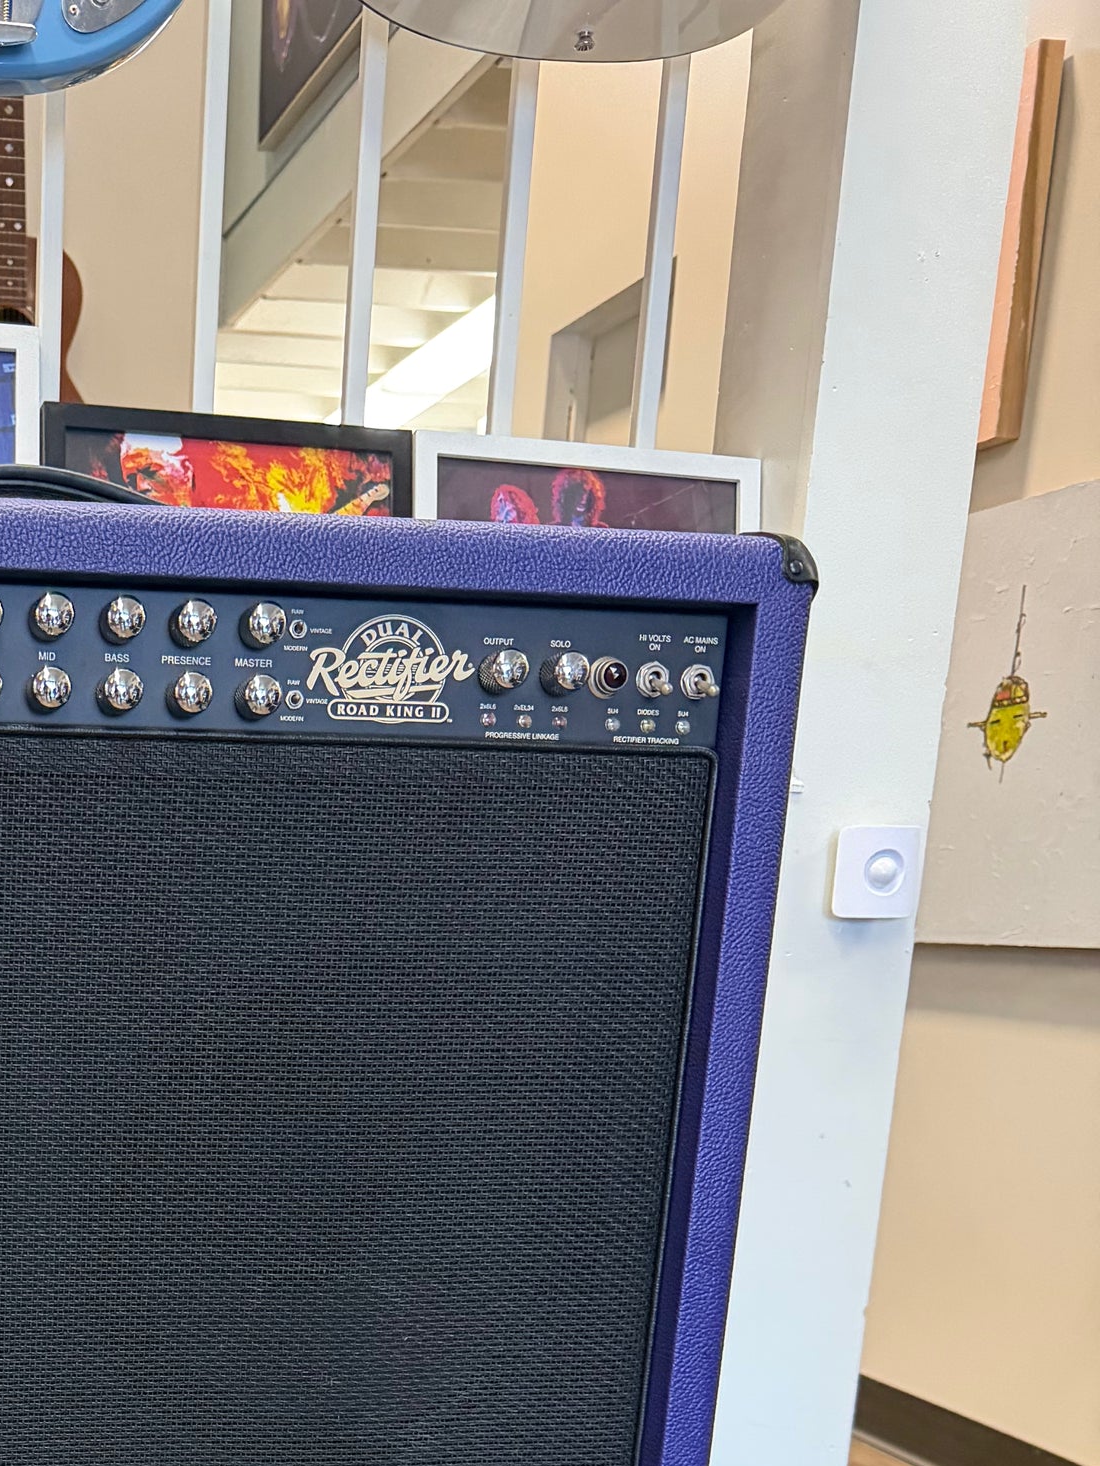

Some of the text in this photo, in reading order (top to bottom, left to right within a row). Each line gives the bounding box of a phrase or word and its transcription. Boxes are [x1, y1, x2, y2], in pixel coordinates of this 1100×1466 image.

[360, 621, 424, 647] DUAL
[649, 634, 671, 642] VOLTS
[483, 637, 514, 646] OUTPUT
[551, 640, 571, 648] SOLO
[684, 636, 694, 644] AC
[649, 643, 660, 651] ON
[694, 645, 706, 653] ON
[38, 651, 56, 661] MID
[104, 653, 130, 663] BASS
[161, 655, 211, 666] PRESENCE
[234, 657, 272, 668] MASTER
[306, 647, 476, 700] Rectifier
[337, 703, 441, 718] ROAD KING II
[485, 731, 530, 740] PROGRESSIVE
[613, 735, 679, 745] RECTIFIER TRACKING
